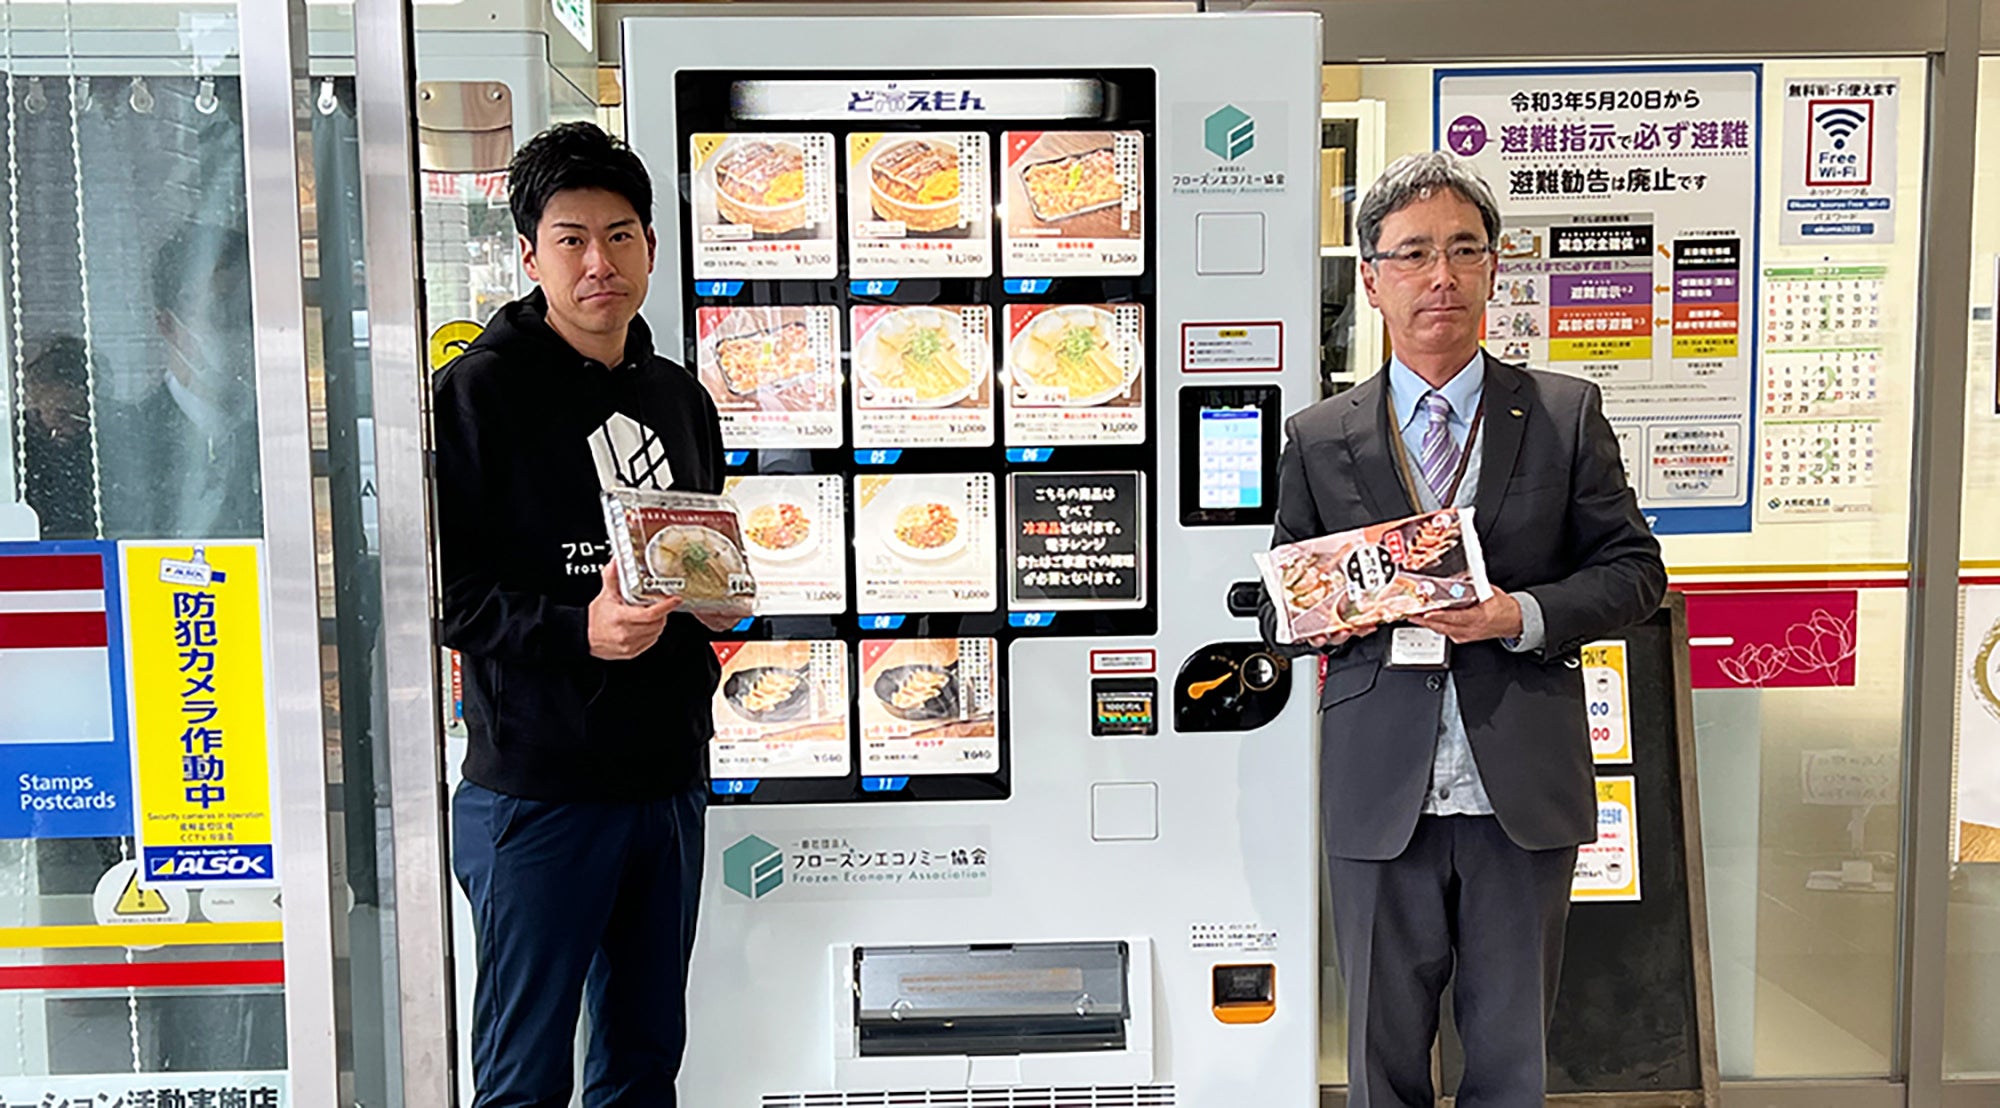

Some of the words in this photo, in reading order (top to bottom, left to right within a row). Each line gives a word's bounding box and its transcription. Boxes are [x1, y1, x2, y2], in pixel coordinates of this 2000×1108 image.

[1510, 89, 1700, 112] 令和3年5月20日から
[1499, 120, 1749, 154] 避難指示で必ず避難
[1818, 151, 1857, 164] Free
[1818, 166, 1857, 178] Wi-Fi
[1509, 167, 1708, 195] 避難勧告は廃止です
[711, 281, 728, 296] 01
[866, 280, 883, 295] 02
[1020, 279, 1037, 294] 03
[870, 449, 887, 464] 05
[1035, 487, 1116, 502] こちらの商品は
[1057, 504, 1094, 519] すべて
[1022, 520, 1122, 536] 冷凍品となります。
[1044, 537, 1107, 553] 電子レンジ
[173, 591, 225, 809] 防犯カメラ作動中
[19, 773, 94, 792] Stamps
[728, 780, 744, 793] 10
[878, 777, 893, 791] 11
[20, 791, 117, 811] Postcards
[147, 812, 180, 821] Security
[182, 812, 216, 820] cameras
[227, 811, 265, 820] operation
[175, 855, 267, 875] ALSOK
[791, 847, 987, 870] フローズンエコノミー協会
[792, 872, 839, 883] Frozen
[844, 870, 903, 884] Economy
[908, 869, 987, 881] Association
